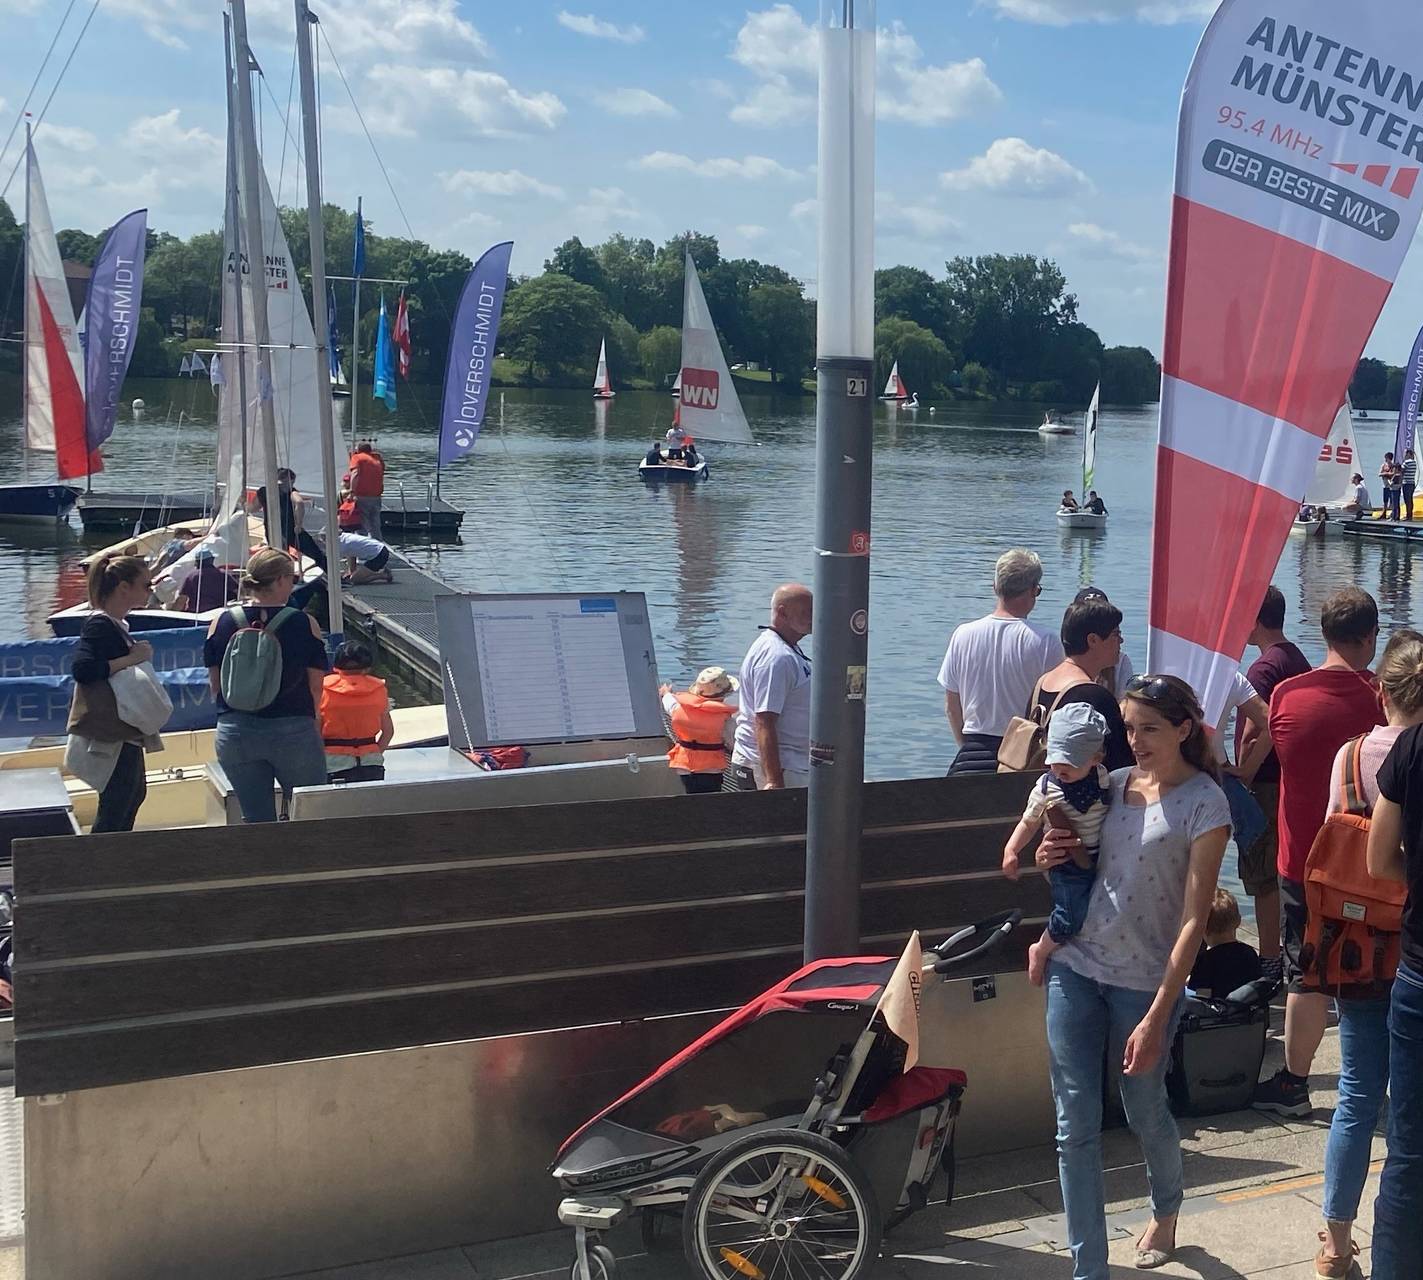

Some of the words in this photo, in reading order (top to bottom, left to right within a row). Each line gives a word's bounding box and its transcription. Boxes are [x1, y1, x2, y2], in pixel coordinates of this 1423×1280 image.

[1217, 105, 1265, 138] 95.4
[1270, 123, 1325, 160] MHz
[1214, 147, 1262, 182] DER
[1264, 166, 1339, 211] BESTE
[1339, 193, 1386, 234] MIX.
[227, 251, 287, 268] ANNNE
[461, 281, 496, 420] OVERSCHMIDT
[682, 383, 718, 407] WN
[849, 380, 866, 395] 21
